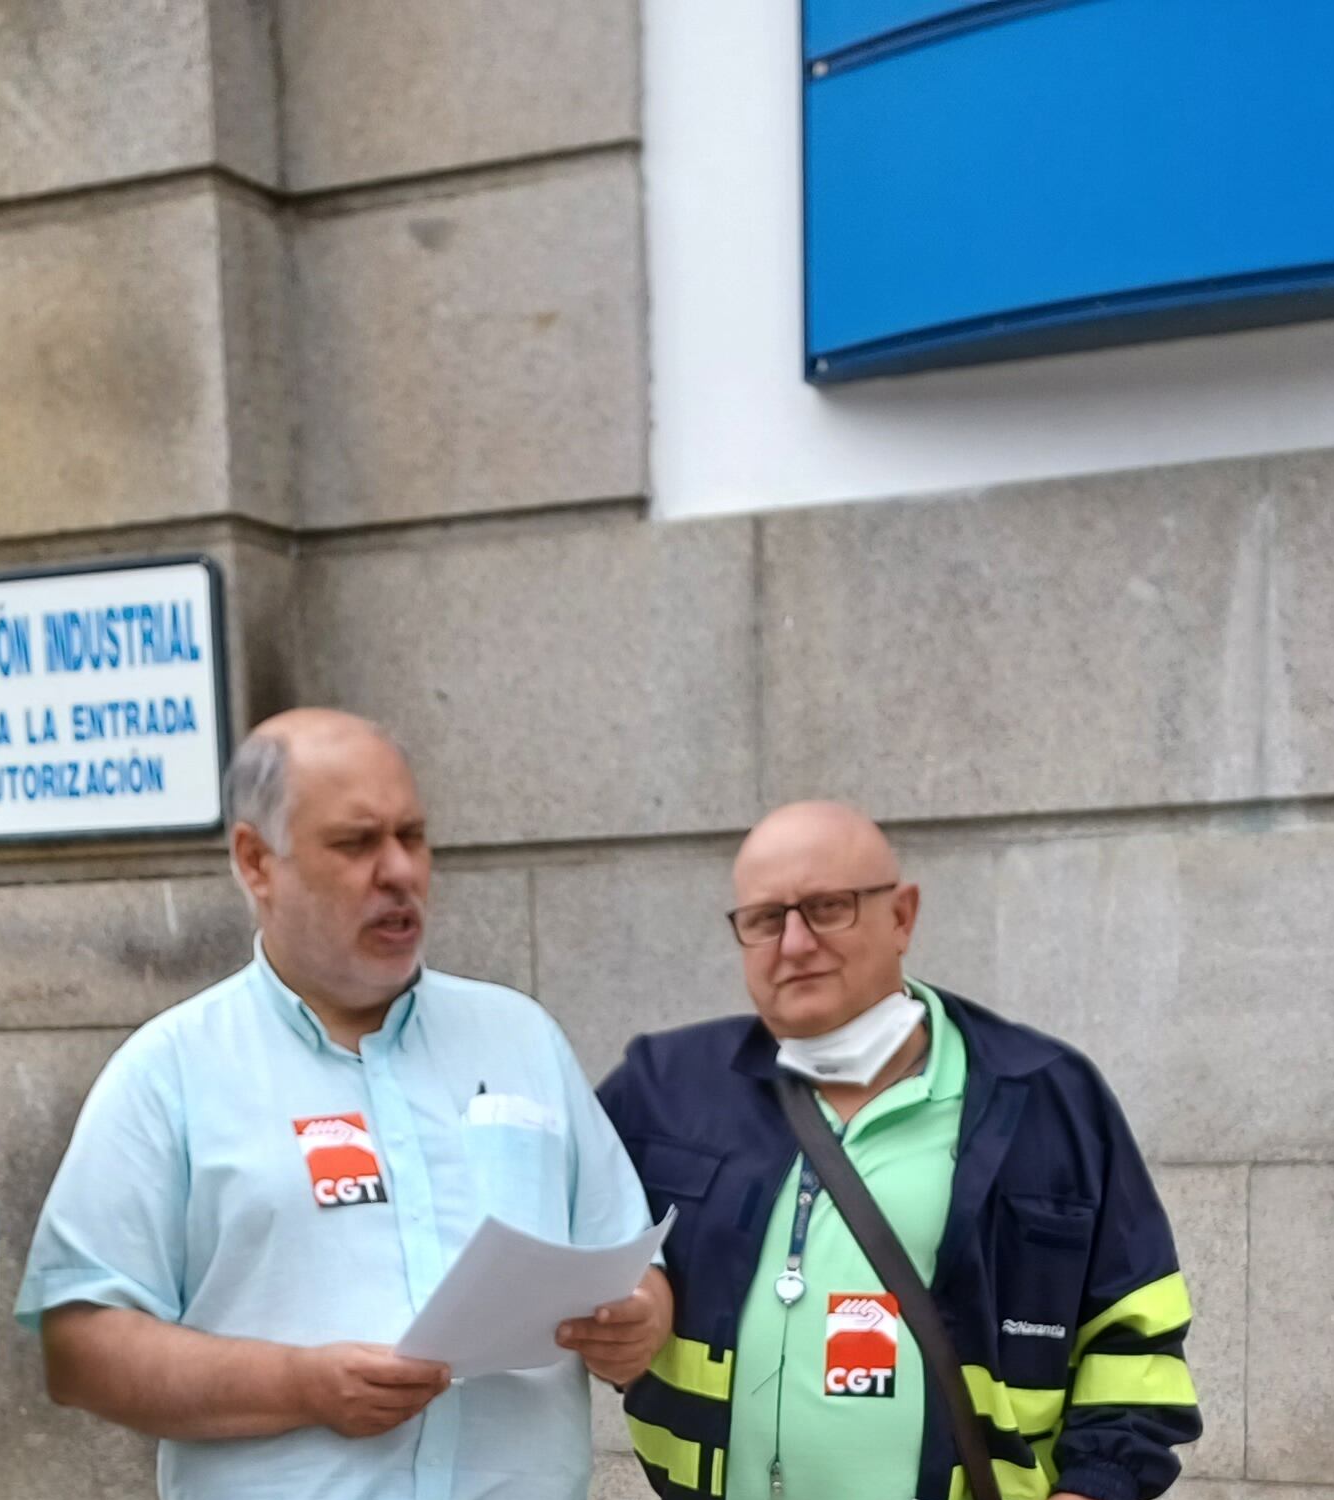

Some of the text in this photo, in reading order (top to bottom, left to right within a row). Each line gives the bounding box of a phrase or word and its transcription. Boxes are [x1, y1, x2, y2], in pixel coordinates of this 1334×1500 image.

[44, 600, 200, 673] INDUSTRIAL
[26, 707, 57, 744] LA
[72, 695, 197, 742] ENTRADA
[314, 1174, 380, 1205] CGT
[826, 1366, 893, 1395] CGT
